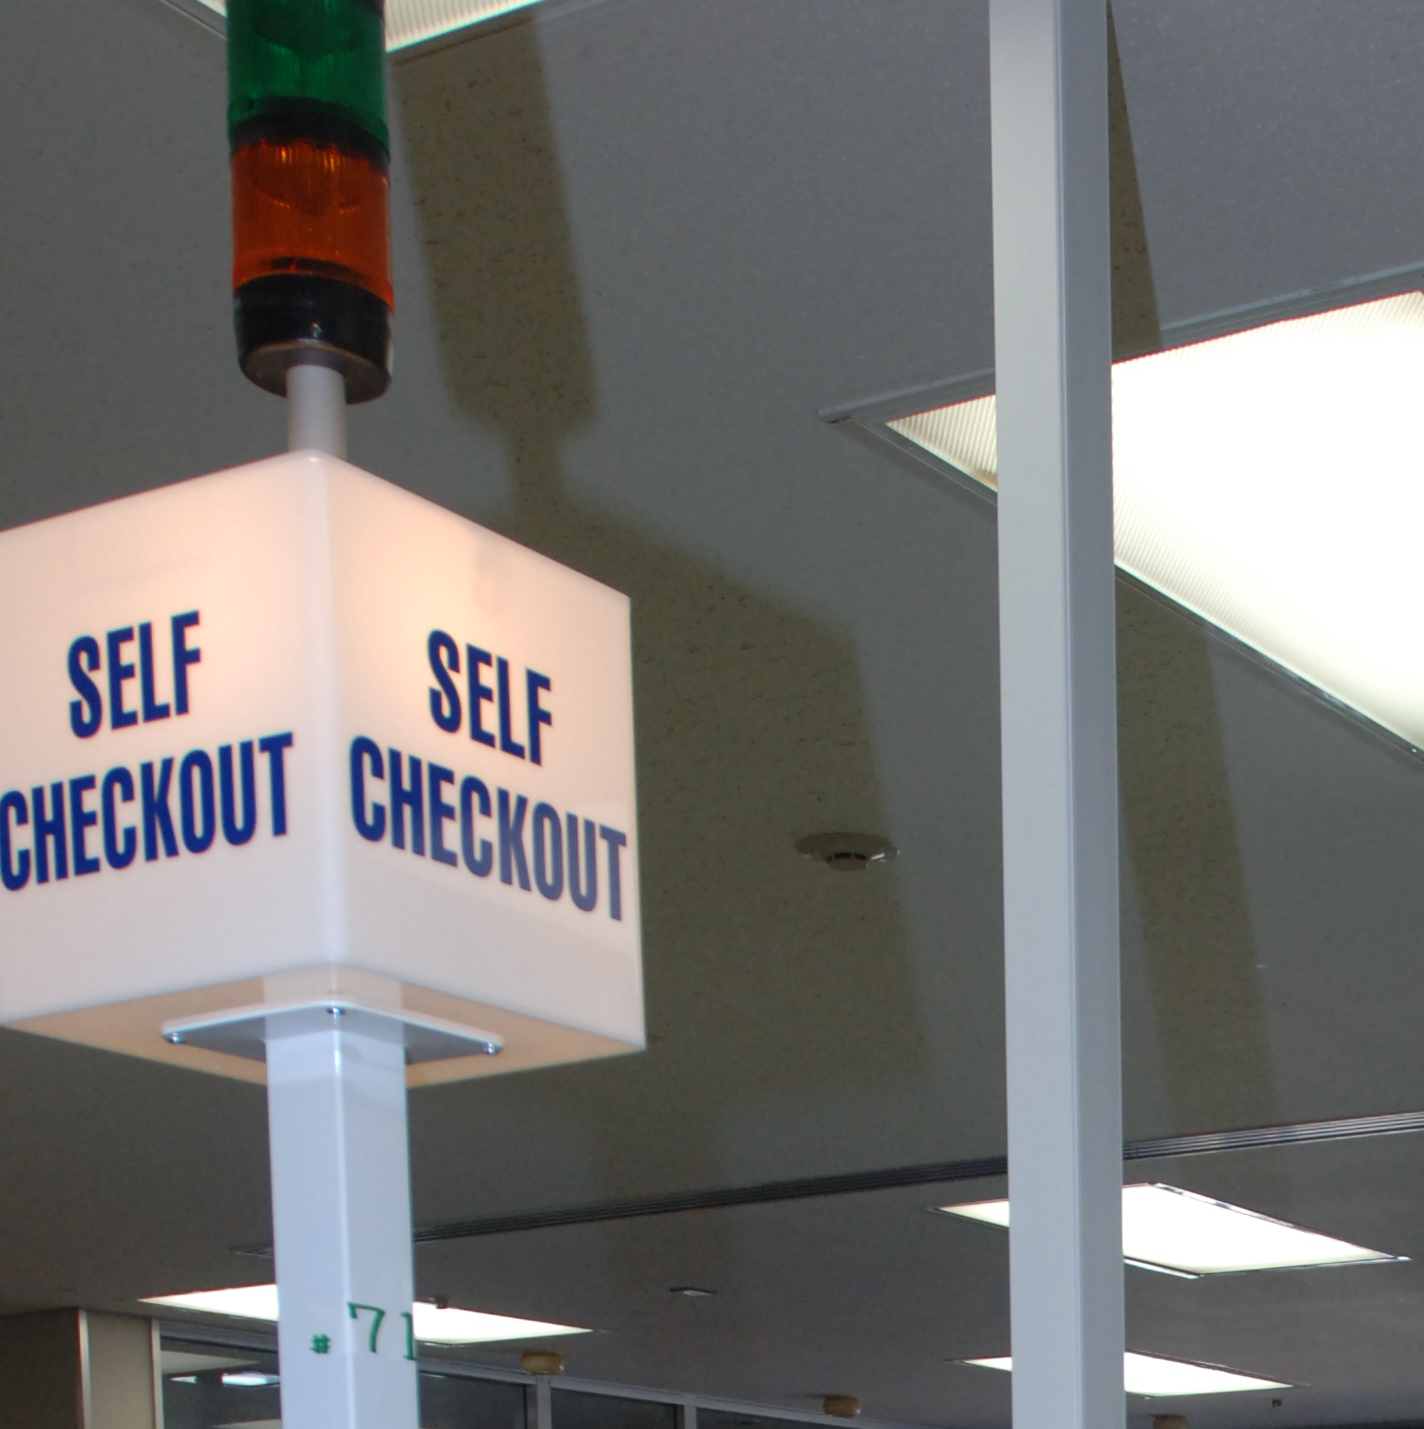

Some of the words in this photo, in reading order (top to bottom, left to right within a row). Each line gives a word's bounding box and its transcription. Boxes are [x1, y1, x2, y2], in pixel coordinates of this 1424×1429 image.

[67, 609, 202, 740] SELF
[426, 628, 553, 767] SELF
[0, 731, 294, 891] CHECKOUT
[349, 734, 627, 923] CHECKOUT
